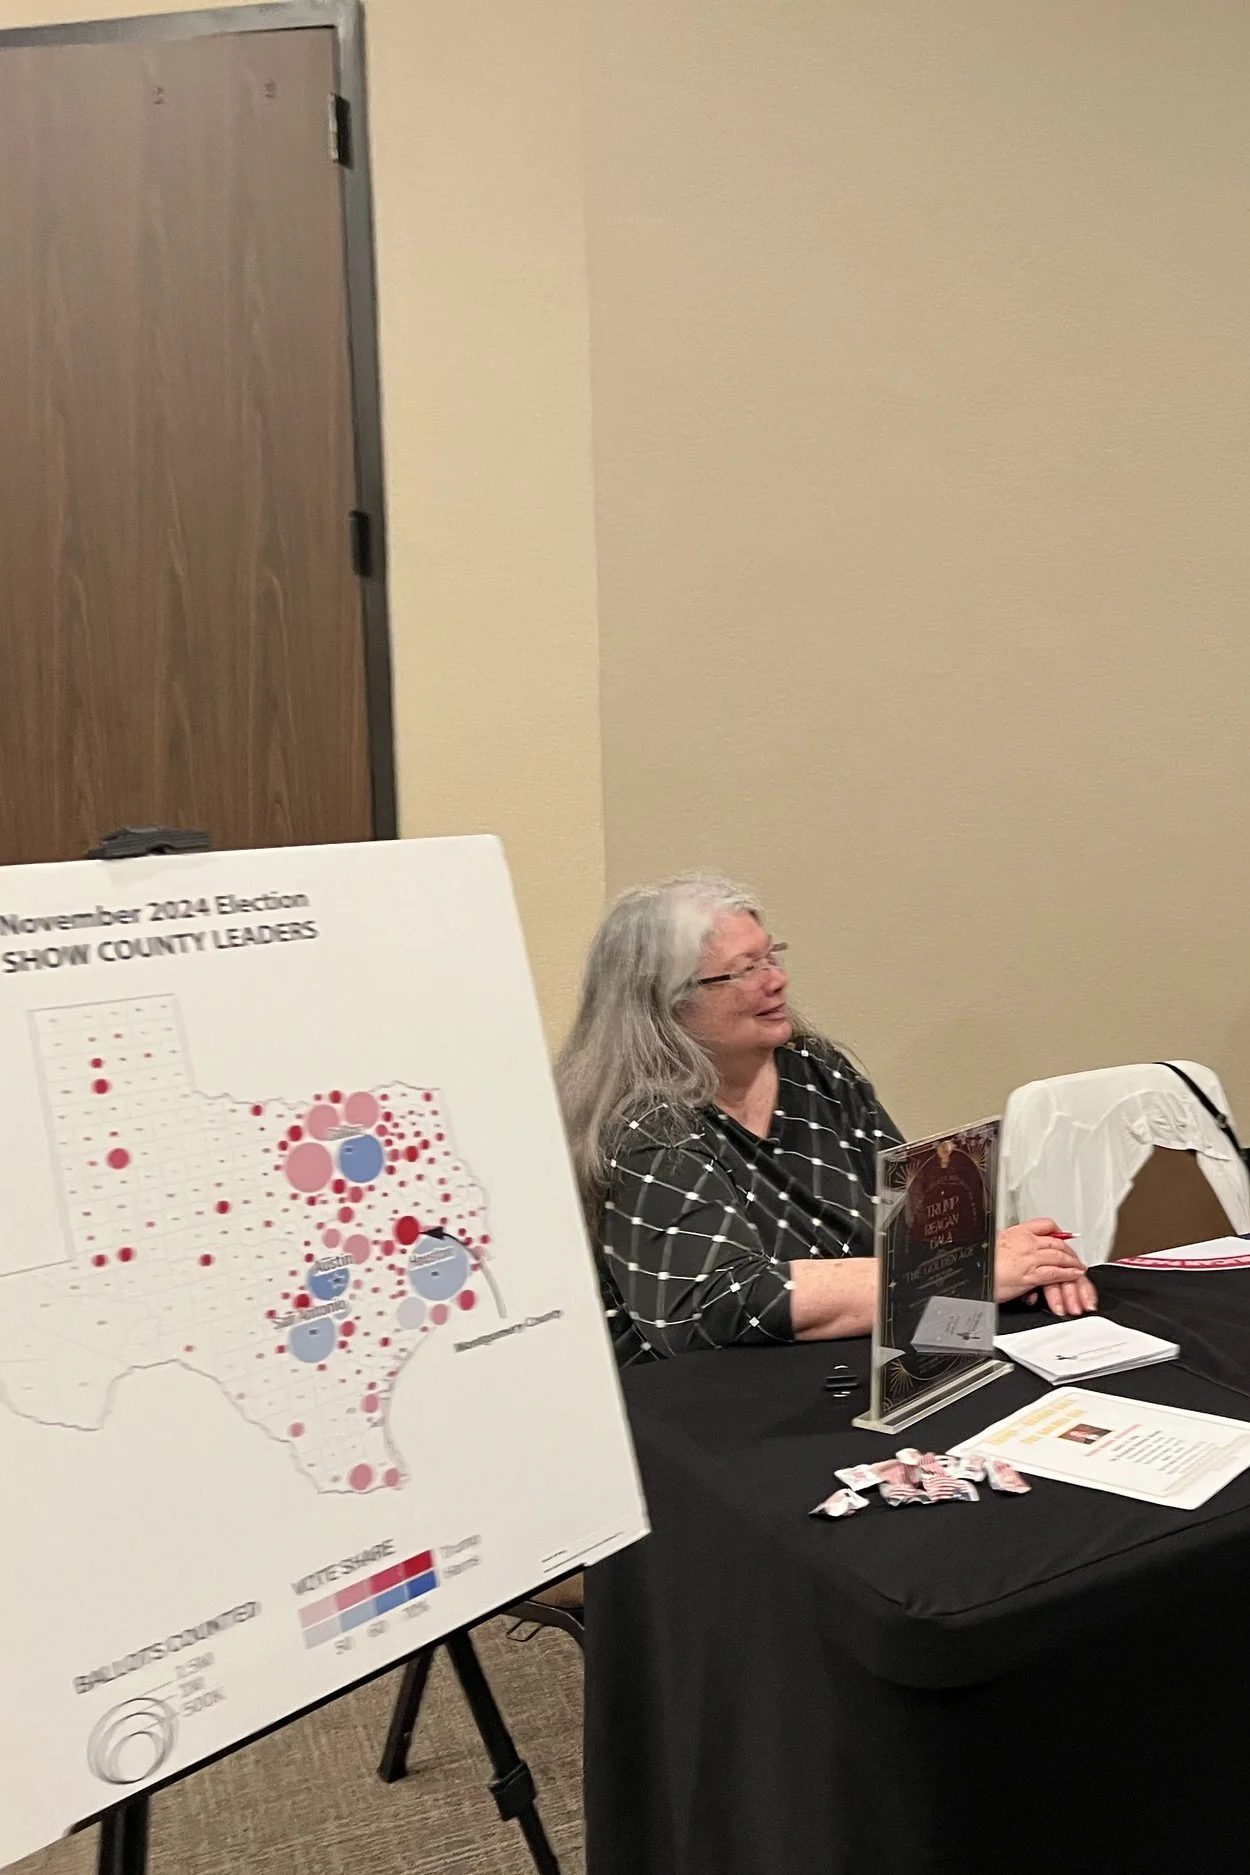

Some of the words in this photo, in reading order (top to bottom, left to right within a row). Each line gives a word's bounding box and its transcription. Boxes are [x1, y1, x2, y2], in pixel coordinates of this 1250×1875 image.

[0, 905, 141, 936] November
[147, 898, 210, 922] 2024
[214, 892, 310, 915] Election
[1, 943, 90, 973] SHOW
[97, 931, 206, 962] COUNTY
[212, 920, 320, 949] LEADERS
[313, 1252, 354, 1274] Austin
